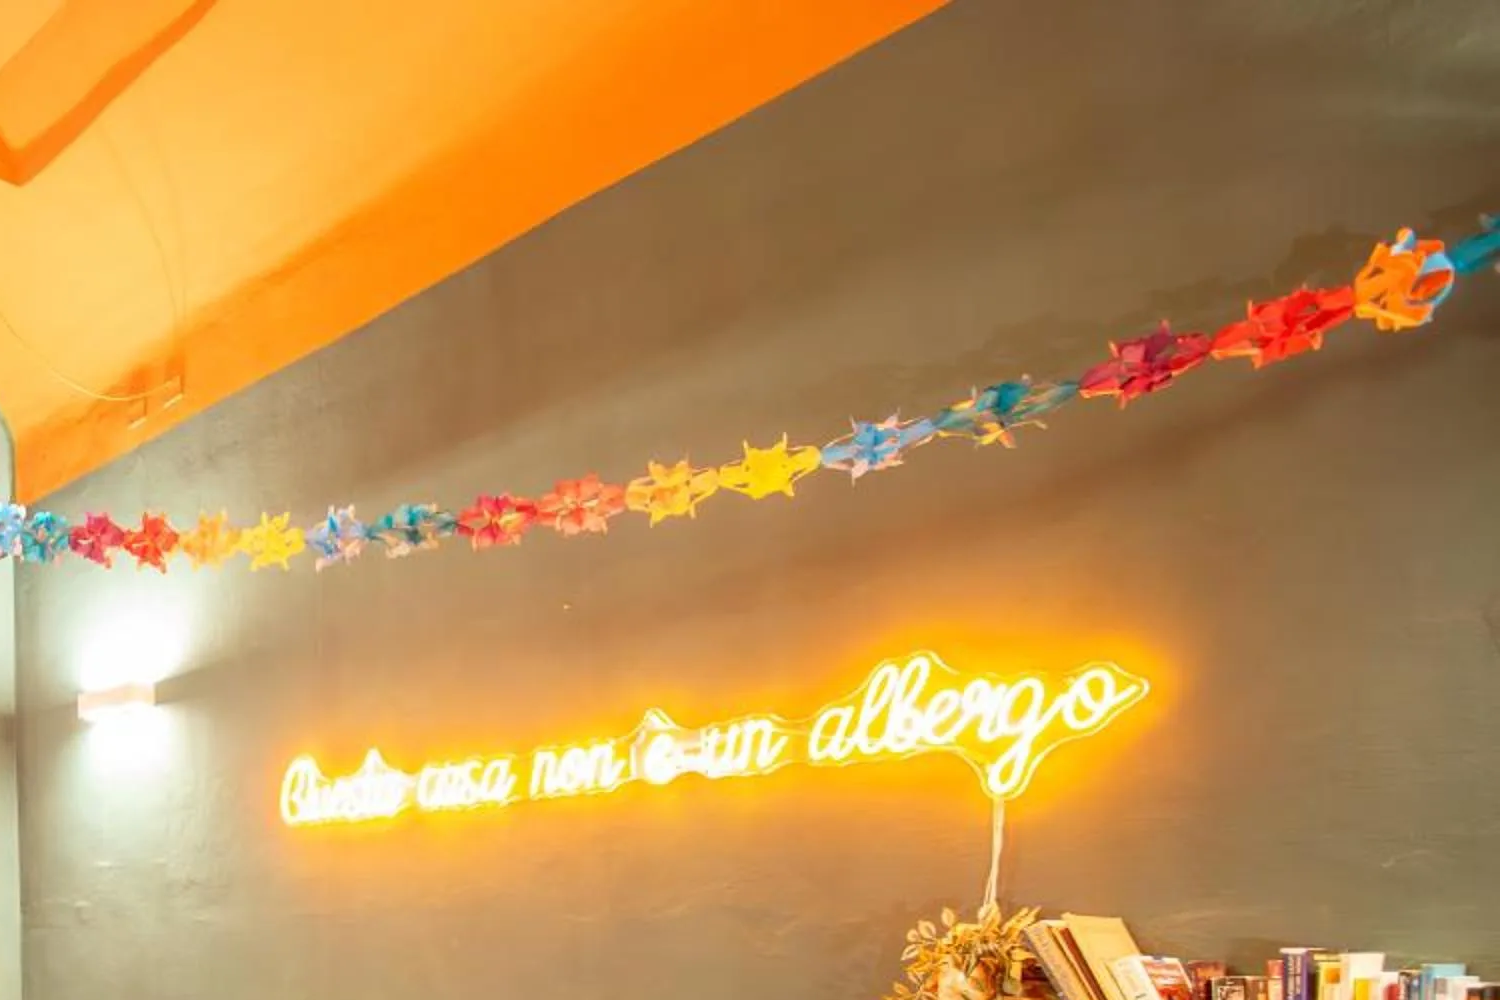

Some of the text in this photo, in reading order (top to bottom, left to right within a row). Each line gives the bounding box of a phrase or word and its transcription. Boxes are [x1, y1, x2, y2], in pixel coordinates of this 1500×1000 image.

[417, 757, 517, 810] casa
[528, 740, 627, 799] non
[701, 718, 789, 780] un
[807, 655, 1144, 795] albergo
